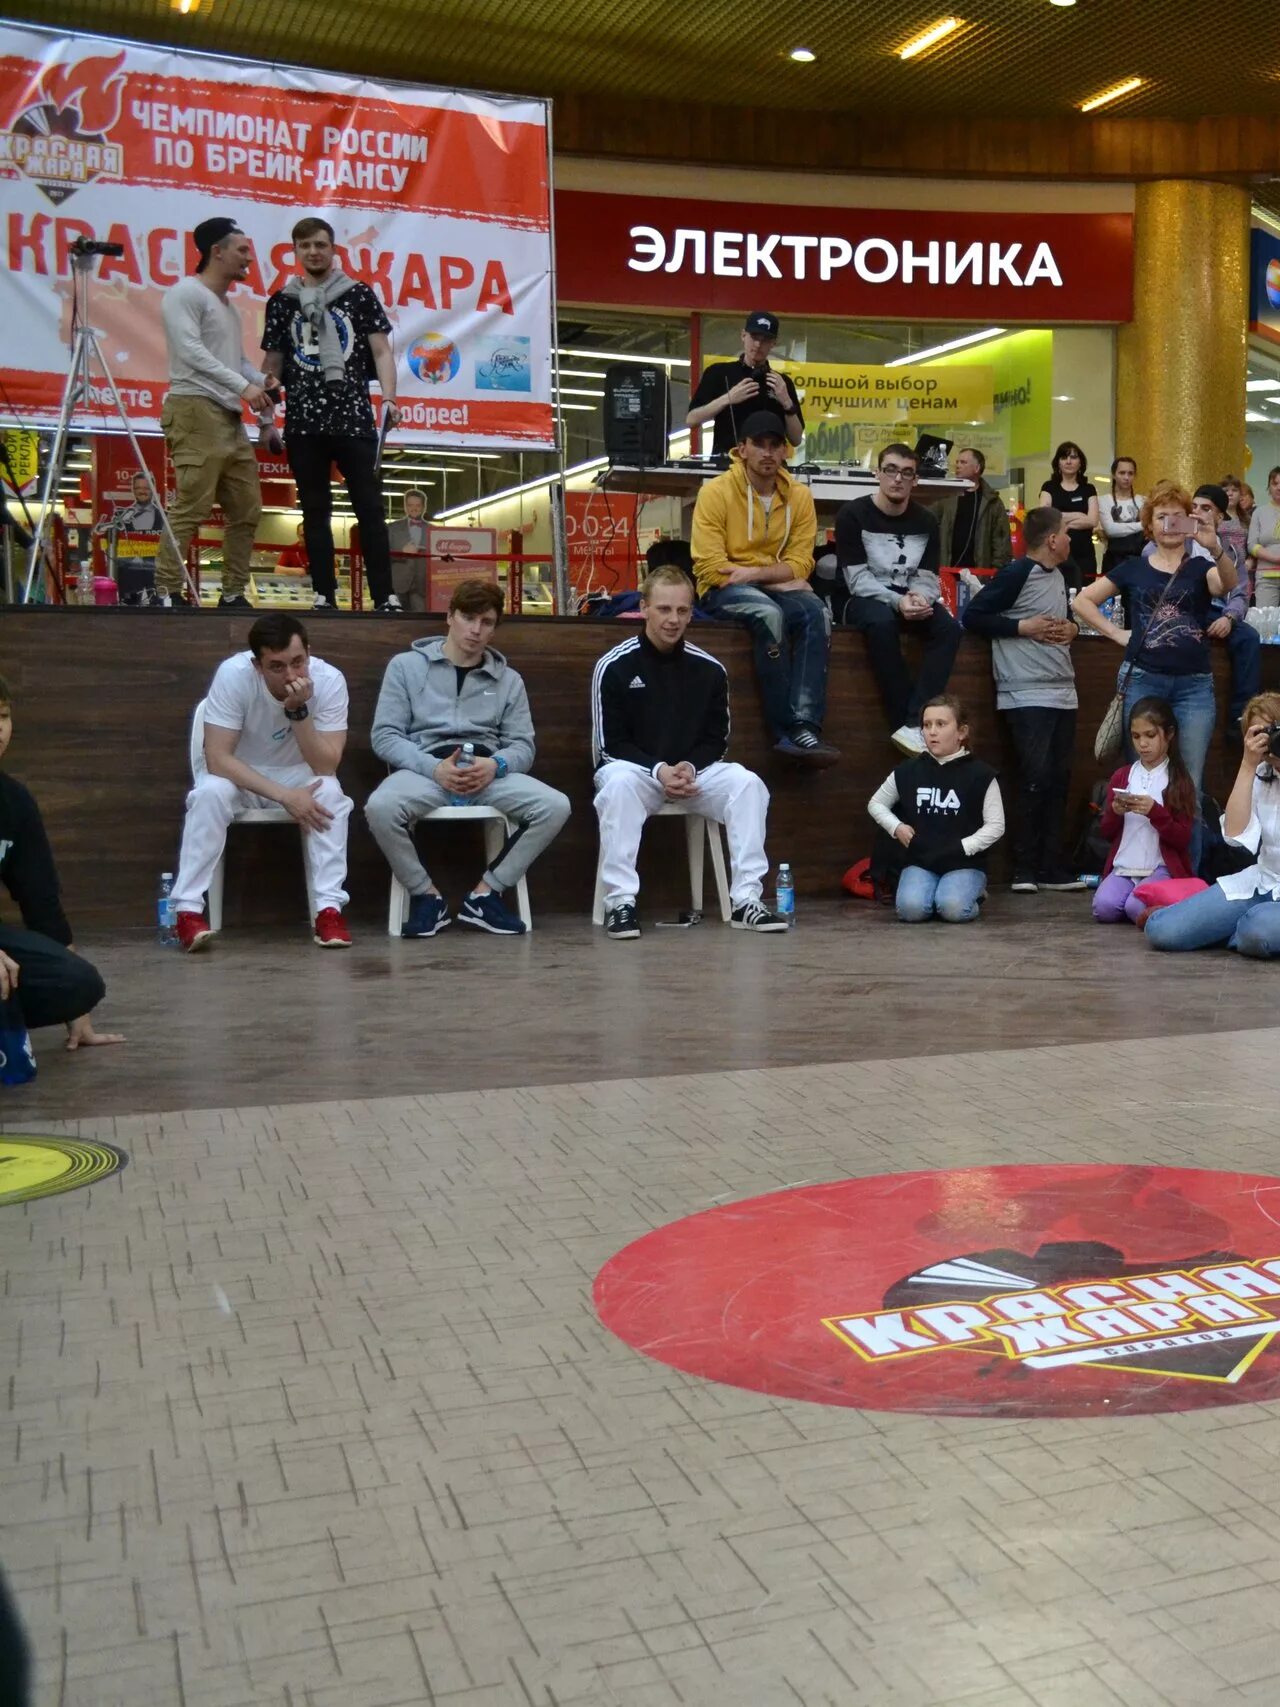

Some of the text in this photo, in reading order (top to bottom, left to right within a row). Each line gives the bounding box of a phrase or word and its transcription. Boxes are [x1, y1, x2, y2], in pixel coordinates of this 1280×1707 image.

[132, 100, 429, 163] ЧЕМПИОНАТ РОССИИ
[154, 137, 410, 193] ПО БРЕЙК-ДАНСУ
[8, 212, 303, 297] КРАСАЯ
[627, 226, 1064, 287] ЭЛЕКТРОНИКА
[784, 372, 938, 397] ольшой выбор
[399, 403, 469, 428] обрее!
[811, 396, 889, 412] лучшим
[897, 396, 958, 411] ценам
[916, 787, 961, 809] FILA
[917, 807, 960, 816] ITALY
[990, 1294, 1266, 1354] ЖАРА
[1103, 1328, 1232, 1356] САРАТОВ
